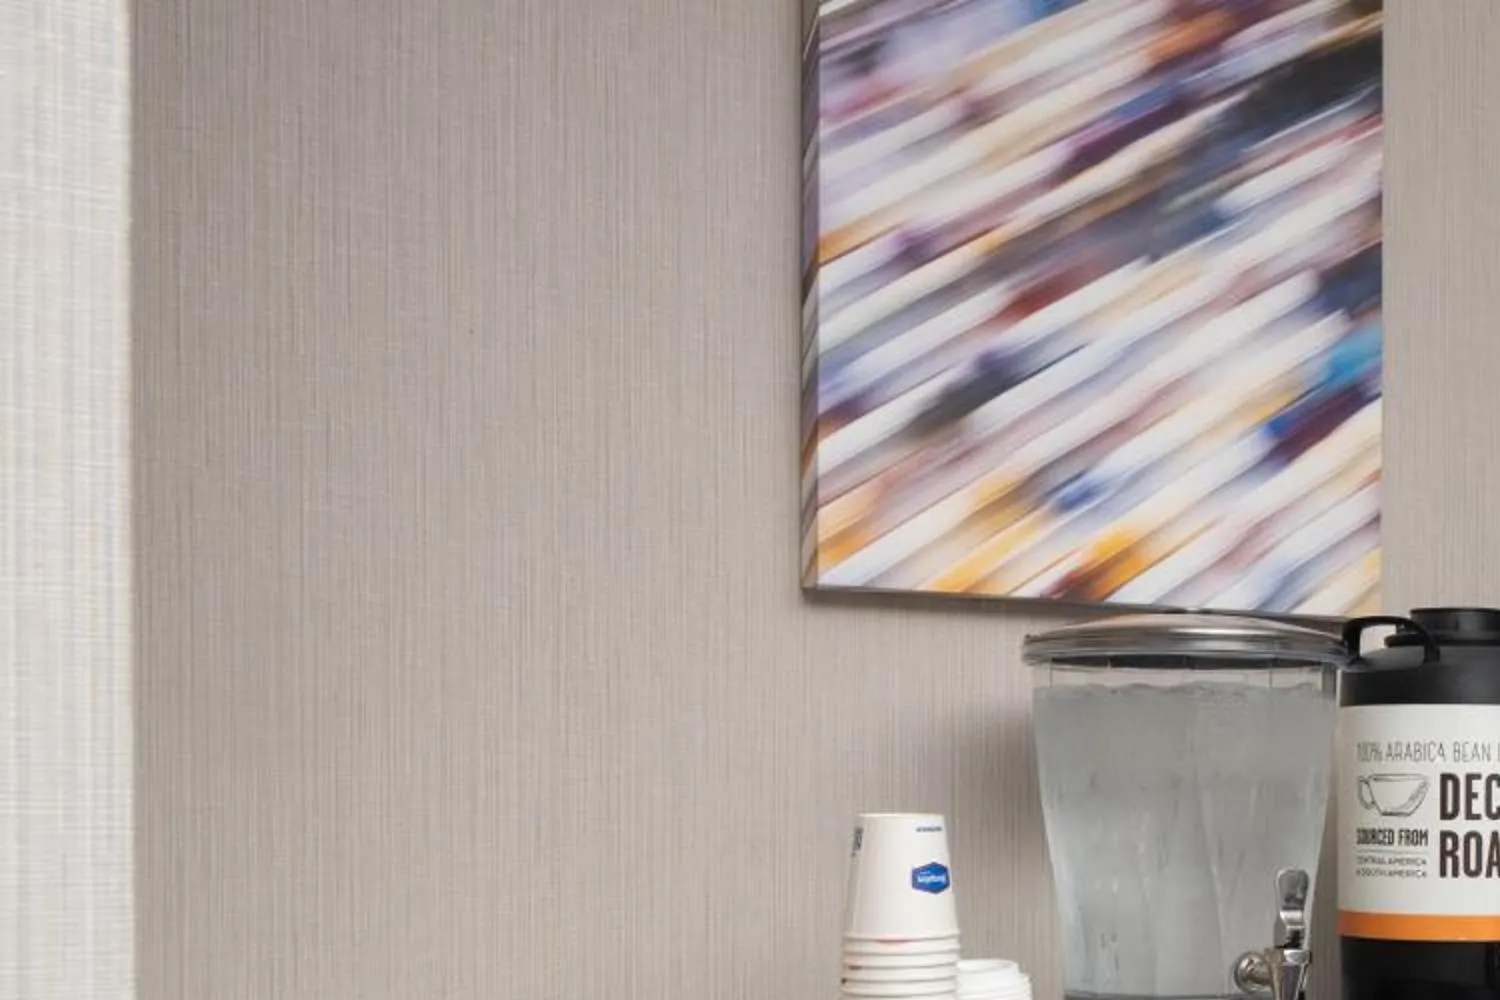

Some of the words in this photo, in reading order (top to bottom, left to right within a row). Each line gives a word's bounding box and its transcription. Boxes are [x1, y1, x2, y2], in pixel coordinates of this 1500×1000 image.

[1386, 741, 1446, 763] ARABICA
[1453, 741, 1491, 763] BEAN
[1398, 828, 1429, 846] FROM
